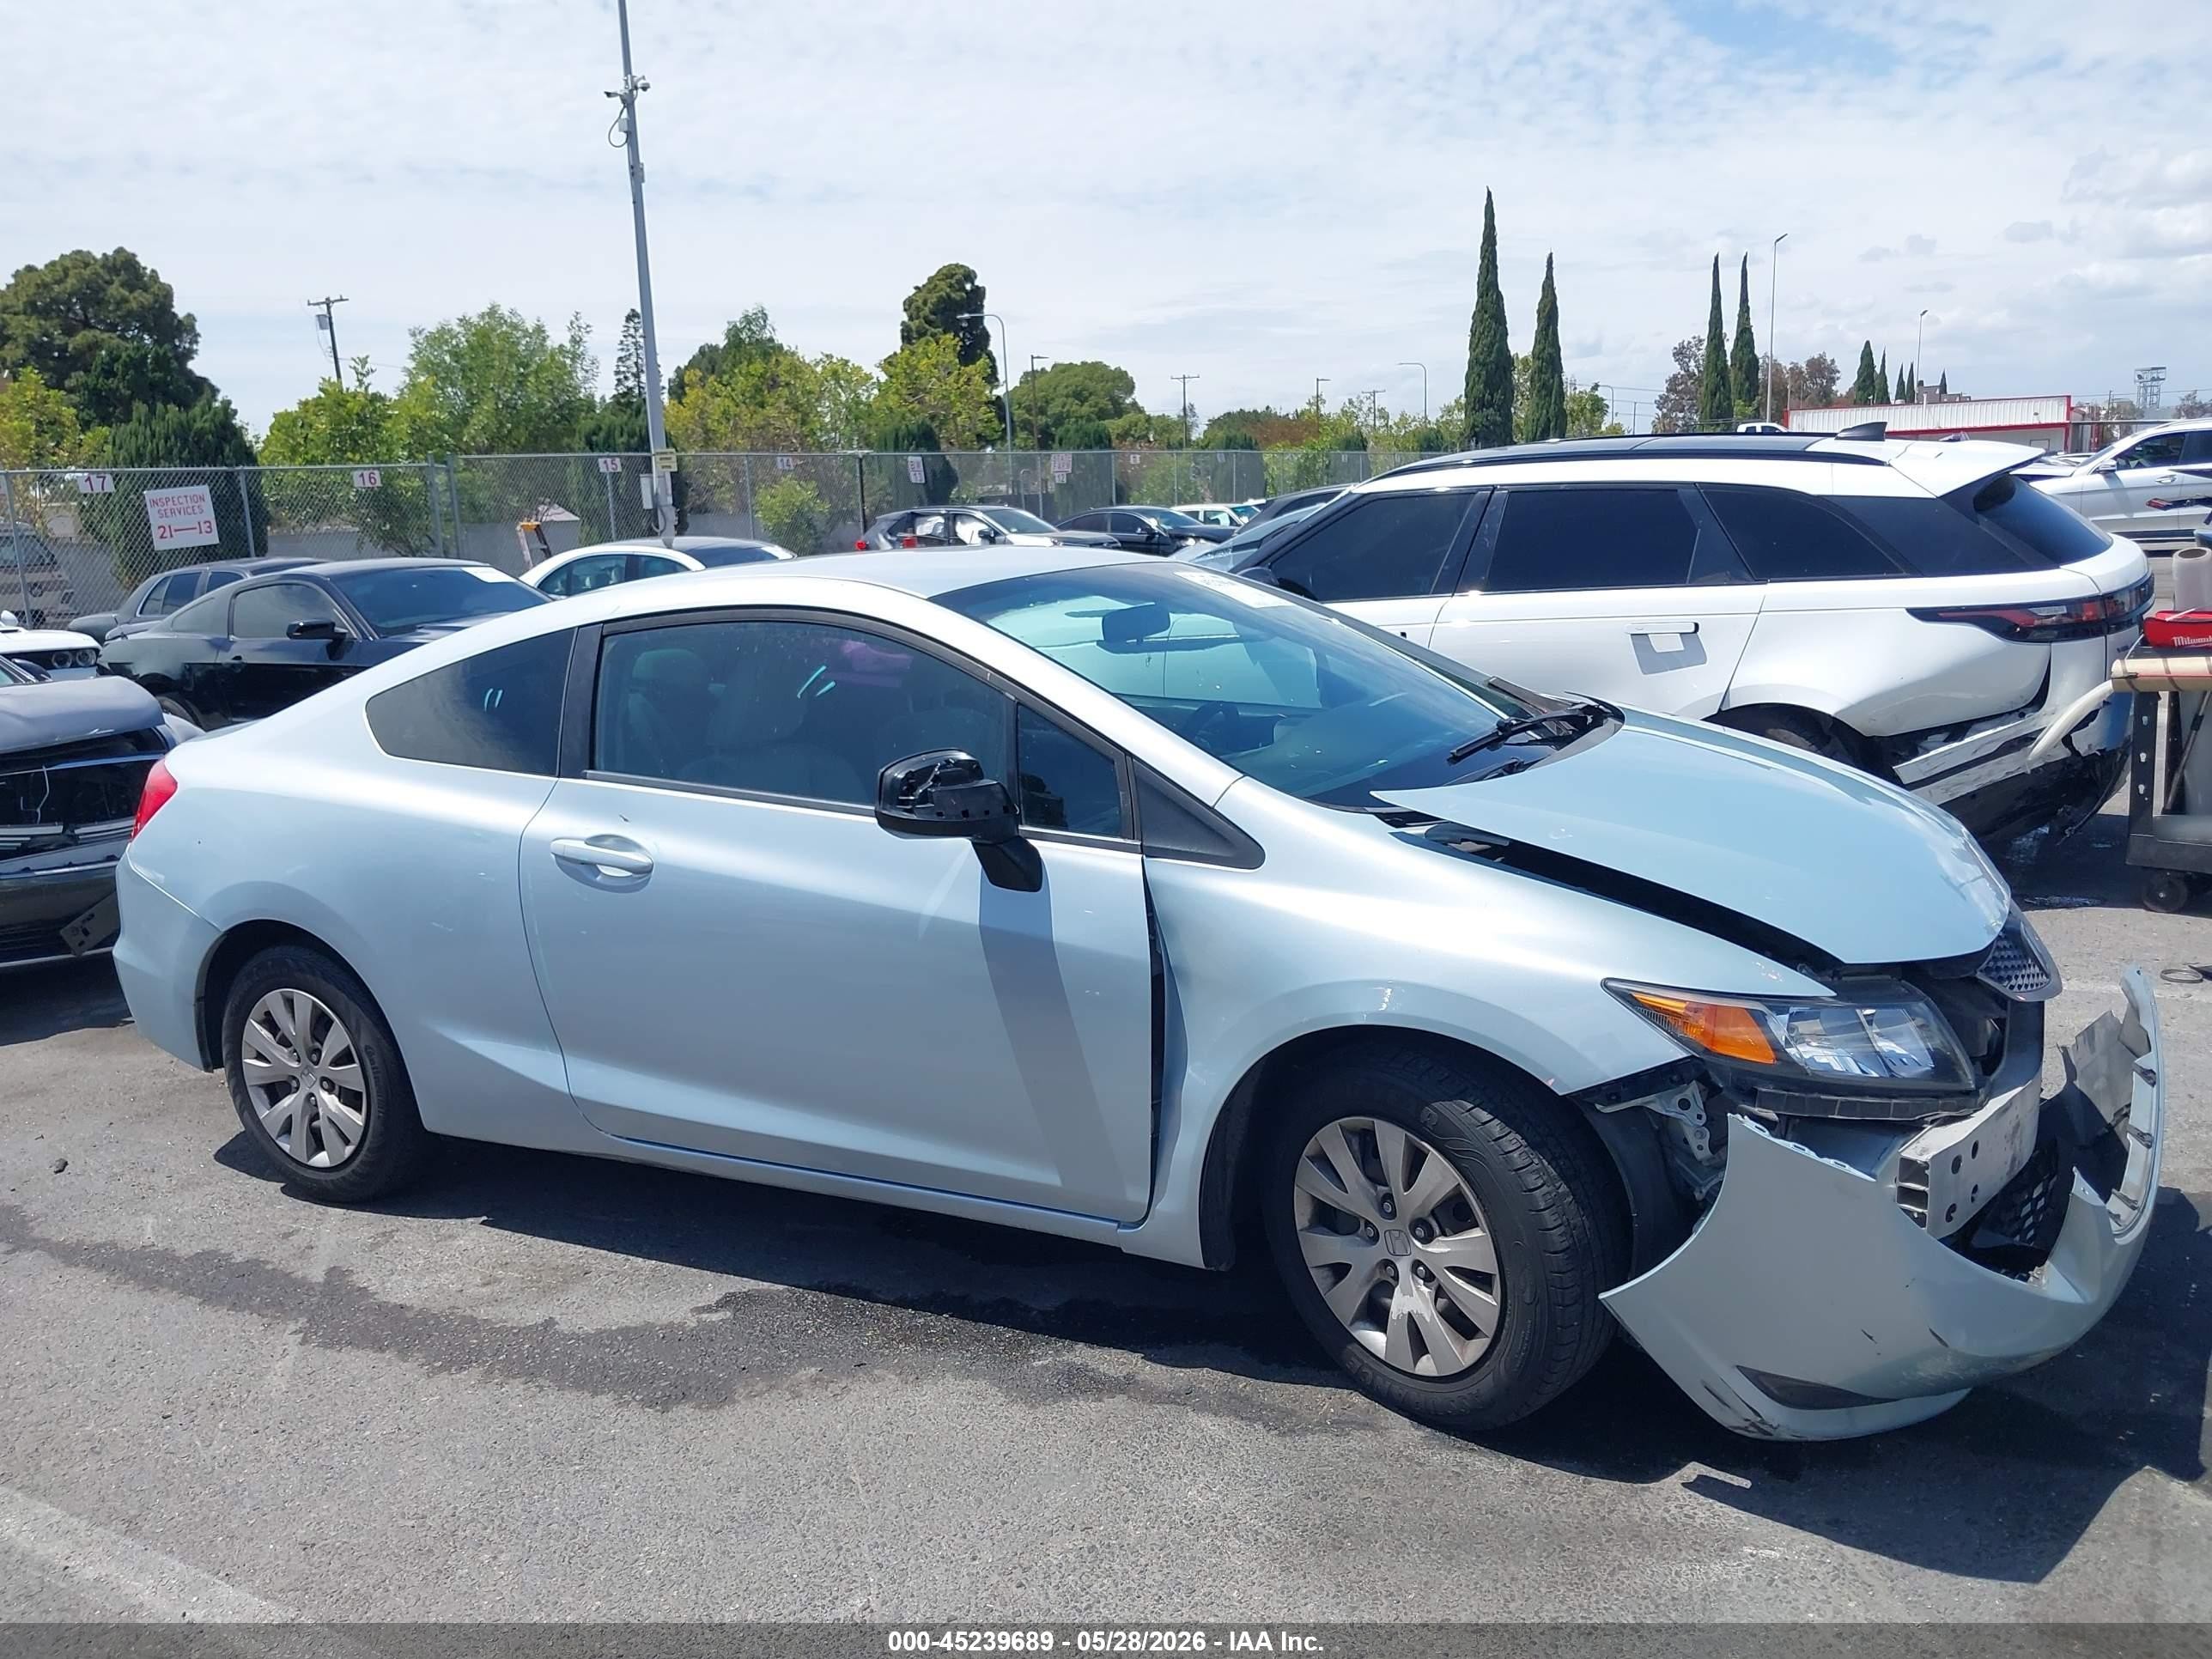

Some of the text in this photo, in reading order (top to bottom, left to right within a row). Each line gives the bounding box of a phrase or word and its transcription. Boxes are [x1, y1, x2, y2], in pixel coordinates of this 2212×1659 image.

[603, 458, 618, 471] 15
[84, 476, 106, 492] 17
[359, 471, 377, 486] 16
[149, 494, 206, 508] INSPECTION
[157, 505, 204, 519] SERVICES
